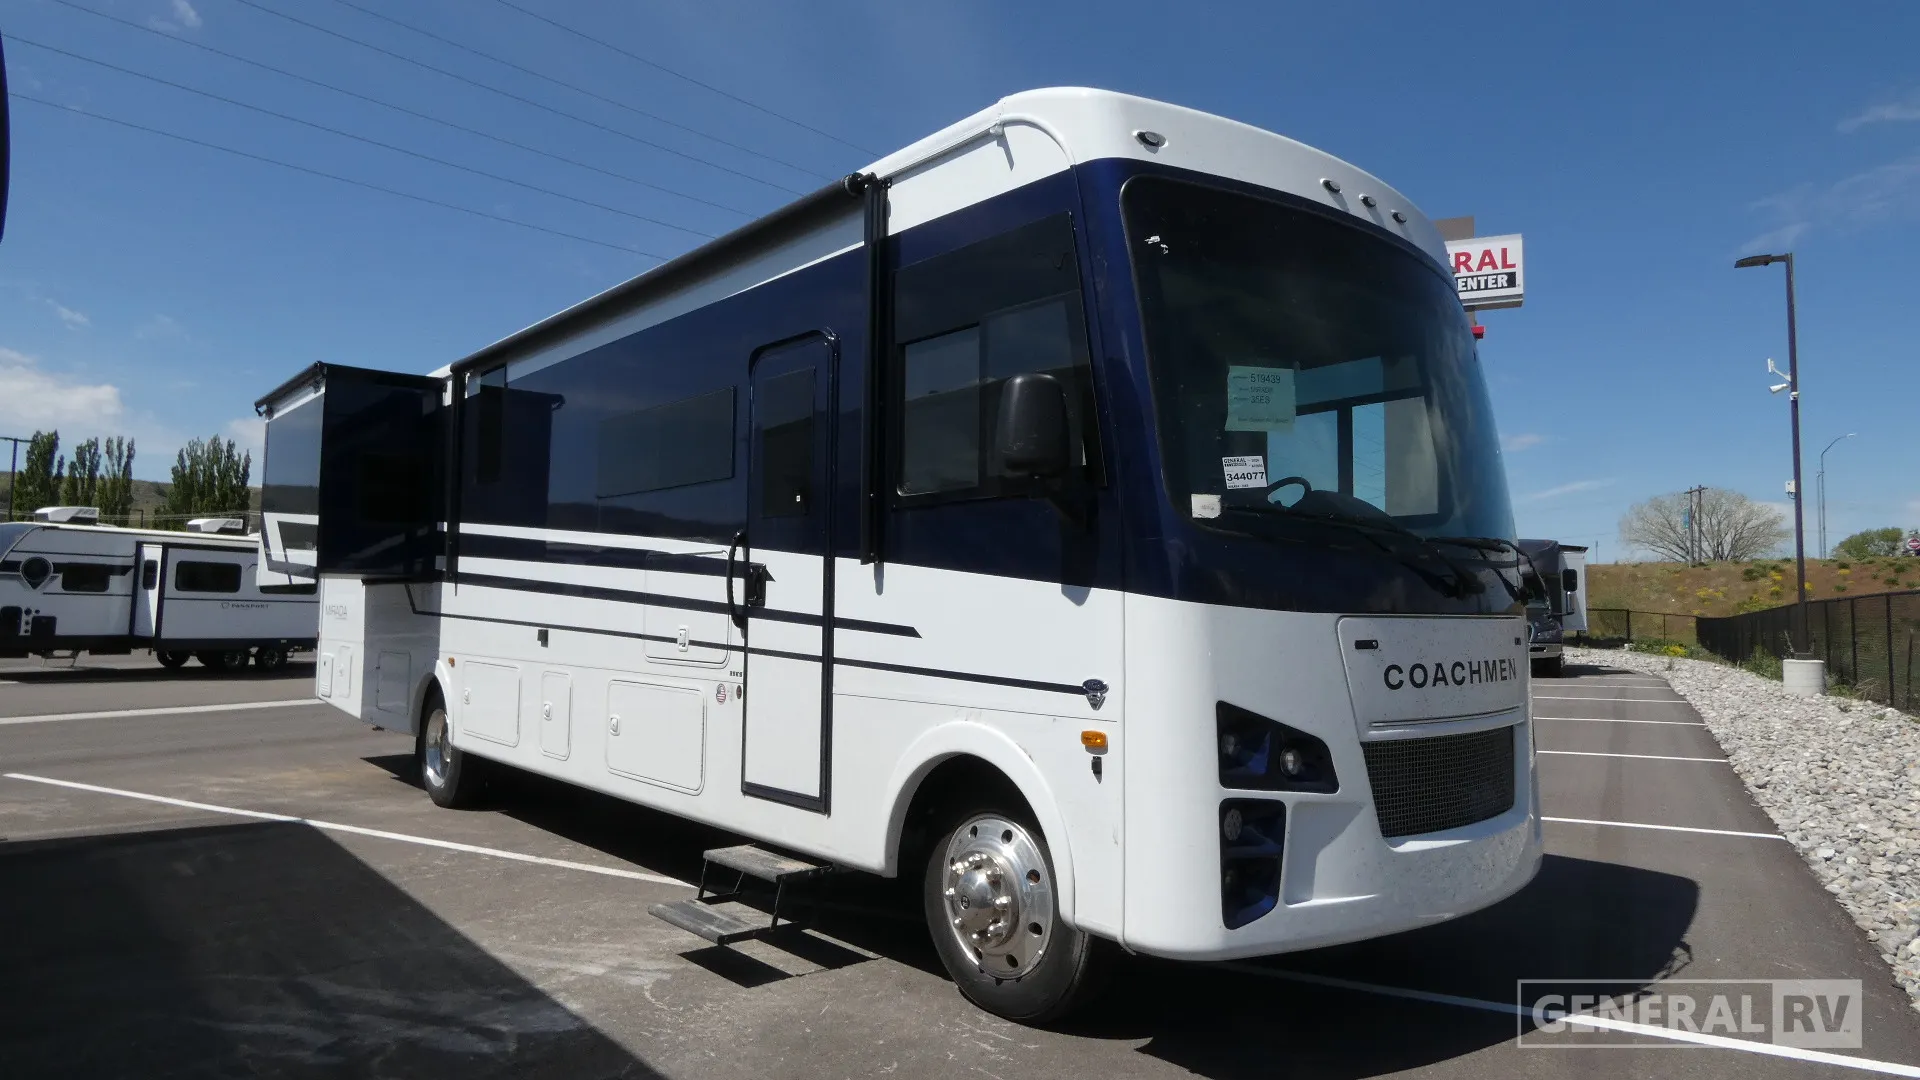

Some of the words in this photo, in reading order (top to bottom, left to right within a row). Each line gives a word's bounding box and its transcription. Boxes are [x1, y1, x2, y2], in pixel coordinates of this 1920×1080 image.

[1457, 274, 1508, 291] ENTER
[1250, 374, 1281, 384] 519439
[1226, 471, 1265, 482] 344077
[1383, 658, 1517, 691] COACHMEN
